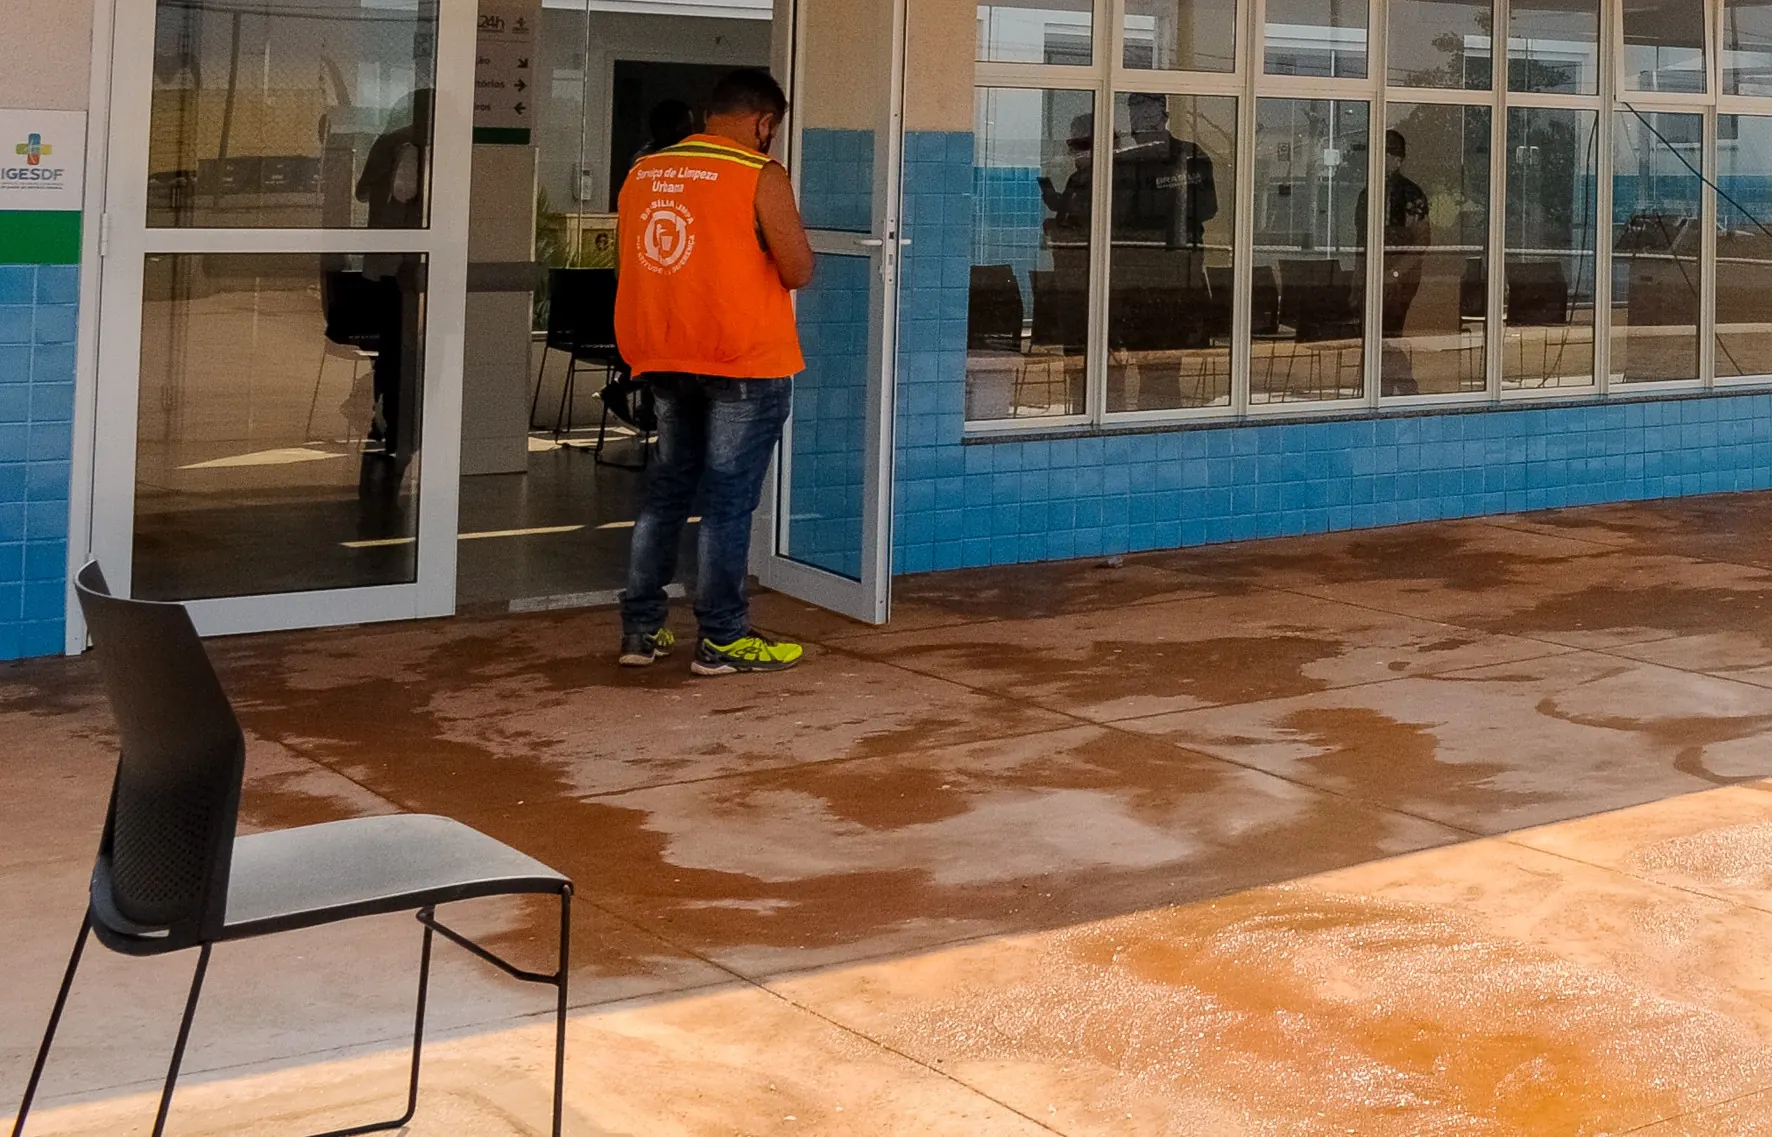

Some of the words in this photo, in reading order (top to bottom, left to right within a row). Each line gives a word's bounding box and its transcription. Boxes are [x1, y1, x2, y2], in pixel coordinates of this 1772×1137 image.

[1, 168, 64, 181] IGESDF
[664, 167, 677, 178] de
[677, 167, 719, 181] Limpeza
[639, 198, 675, 221] BRSÍLIA
